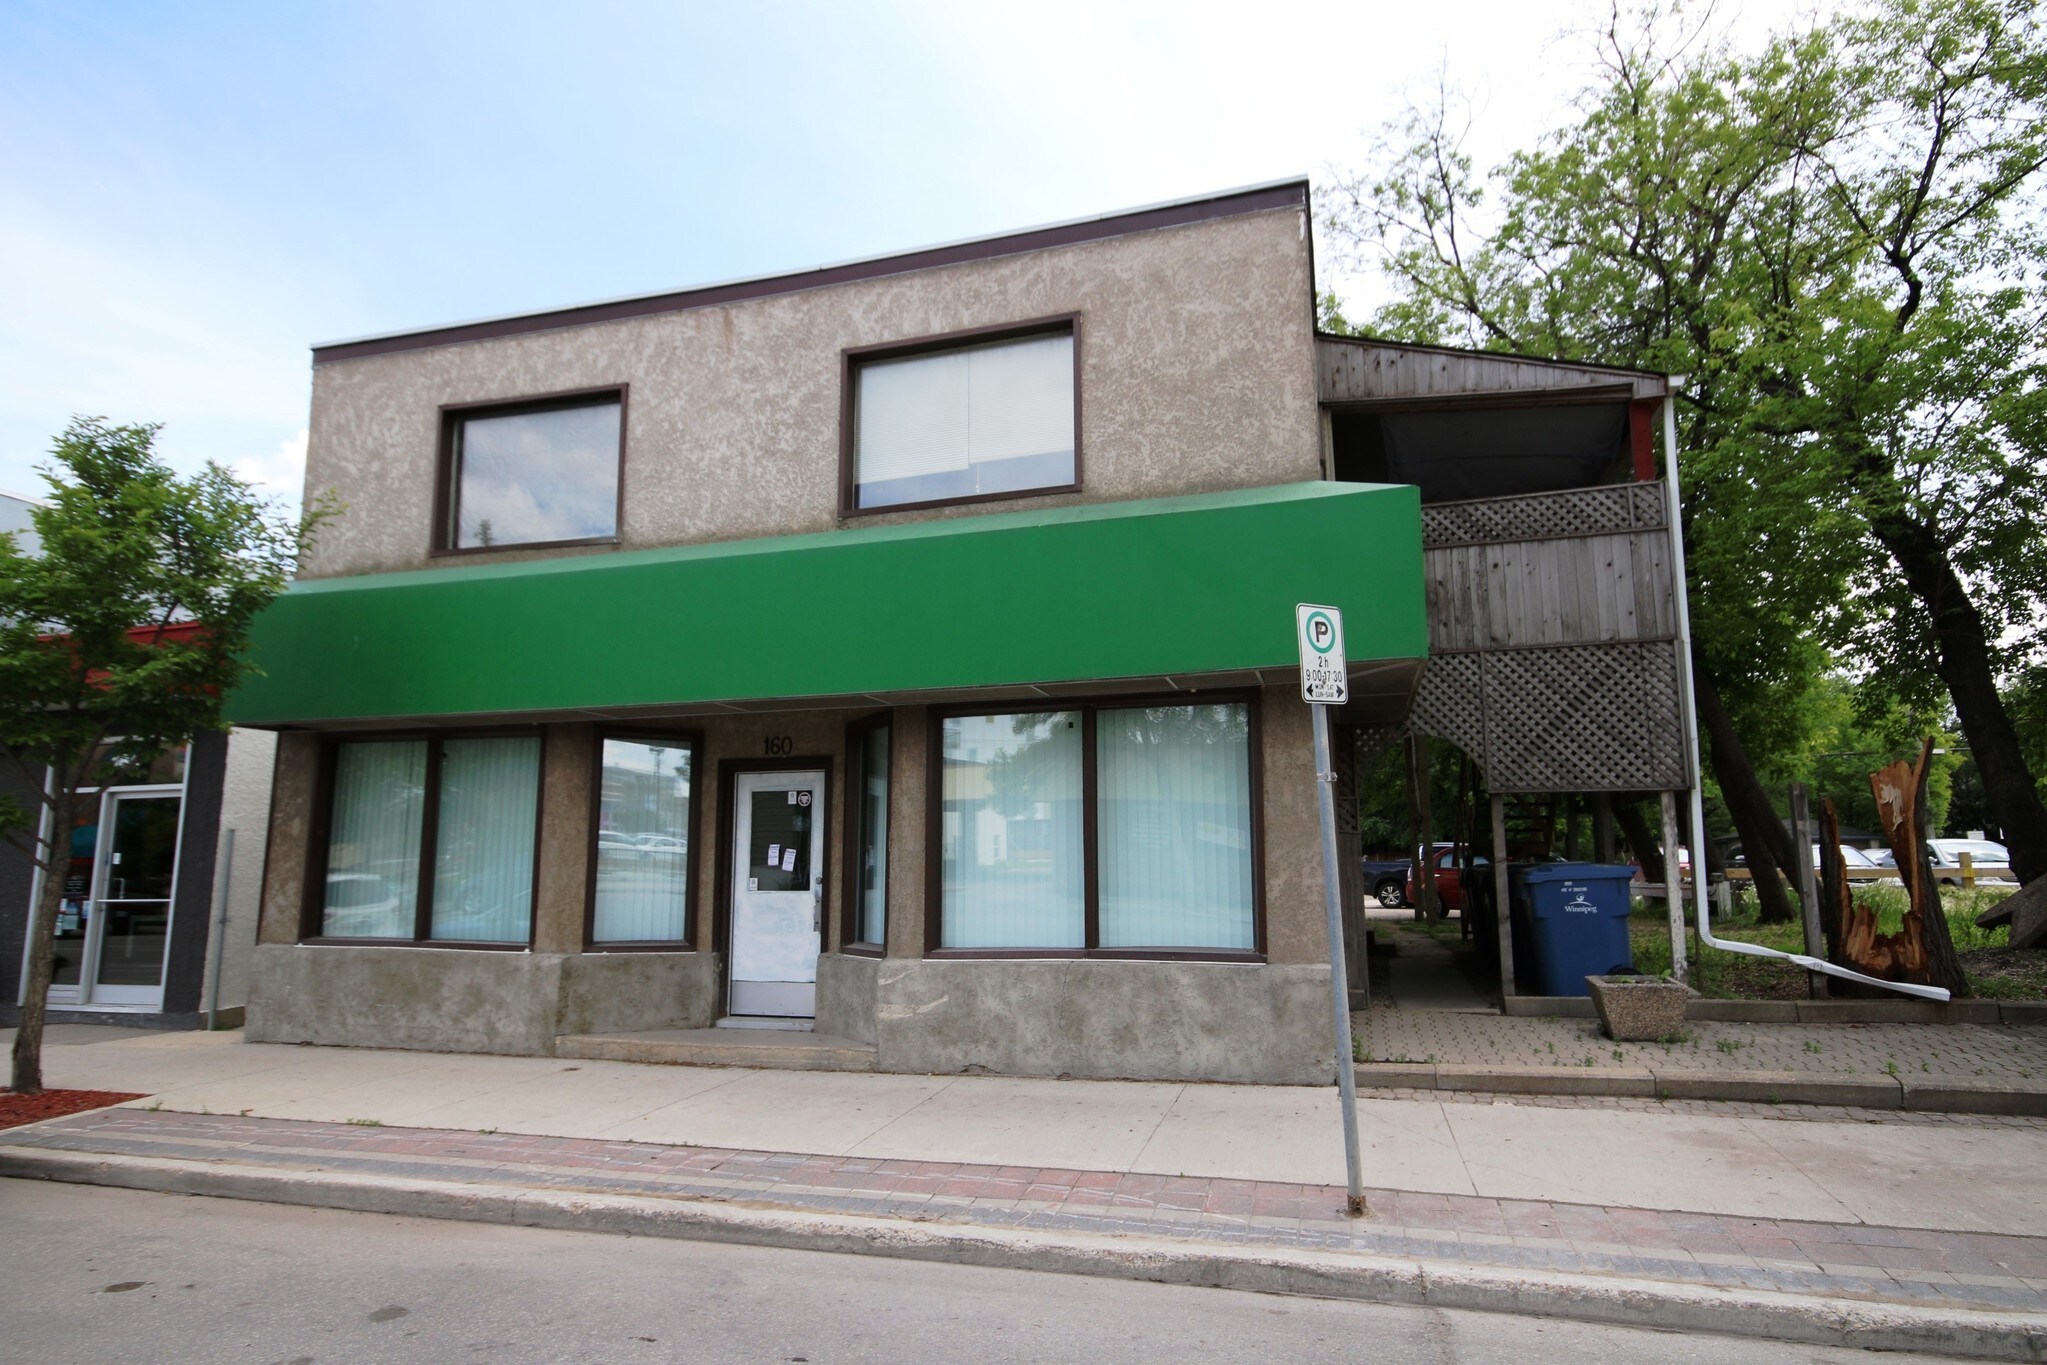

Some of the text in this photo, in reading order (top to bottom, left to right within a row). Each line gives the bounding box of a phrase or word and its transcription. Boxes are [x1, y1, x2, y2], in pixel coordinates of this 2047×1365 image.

[1314, 621, 1329, 643] P
[1318, 656, 1329, 668] 2 h
[763, 735, 793, 755] 160
[1564, 905, 1598, 914] Winnipeg
